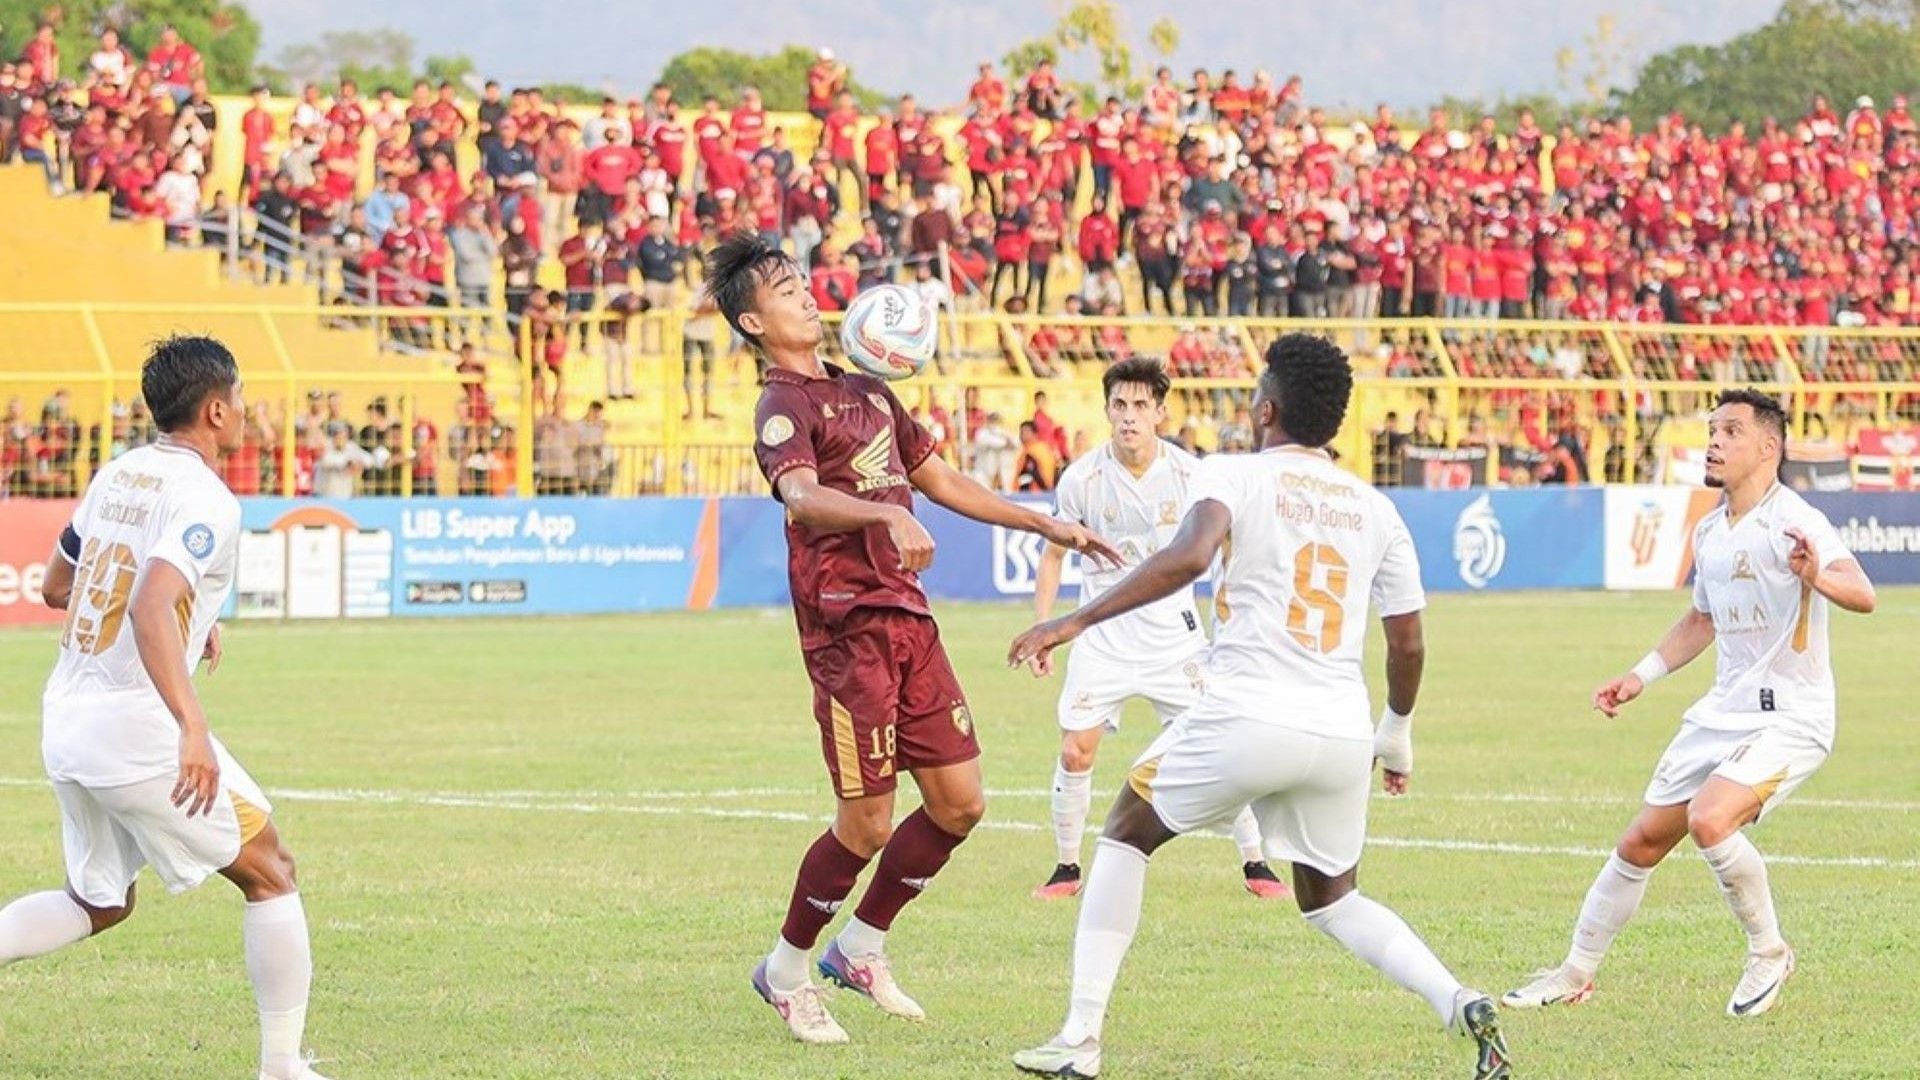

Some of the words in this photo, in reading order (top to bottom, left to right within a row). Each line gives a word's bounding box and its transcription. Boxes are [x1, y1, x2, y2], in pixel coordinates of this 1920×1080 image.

[856, 474, 909, 492] HONDA
[401, 508, 442, 539] LIB
[446, 507, 519, 545] Super
[523, 508, 576, 545] App
[1275, 494, 1313, 526] Hugo
[868, 723, 896, 760] 18
